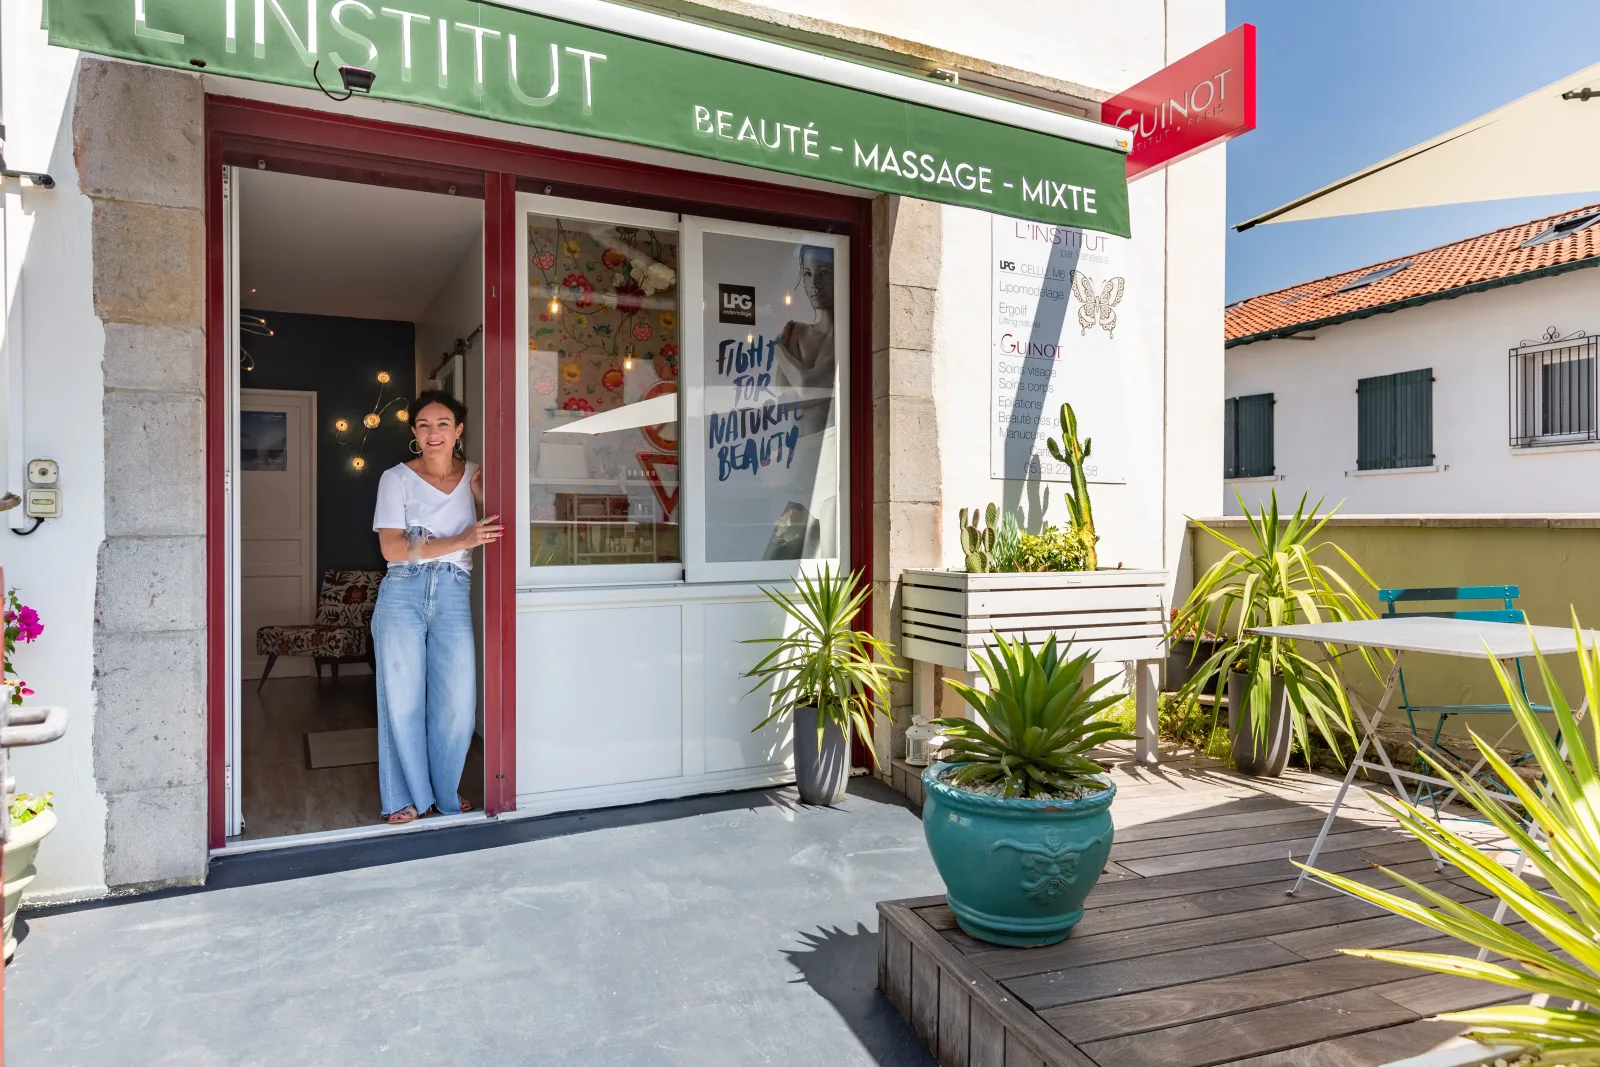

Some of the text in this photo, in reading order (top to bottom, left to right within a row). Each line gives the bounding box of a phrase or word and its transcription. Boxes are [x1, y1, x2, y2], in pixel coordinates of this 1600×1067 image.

[1187, 103, 1225, 128] PARIS
[694, 105, 820, 160] BEAUTÉ
[853, 138, 993, 194] MASSAGE
[1022, 175, 1098, 214] MIXTE
[1015, 221, 1109, 252] L'INSTITUT
[1060, 249, 1074, 260] par
[999, 259, 1016, 271] LPG
[1052, 268, 1066, 279] M6
[723, 292, 753, 310] LPG
[999, 280, 1064, 302] Lipomodelage
[716, 335, 784, 376] FIGHT
[999, 361, 1057, 379] Soins visage
[732, 372, 777, 407] FOR
[999, 378, 1054, 393] Soins corps
[709, 392, 804, 449] NATURAL
[998, 411, 1032, 425] Beauté
[1034, 413, 1051, 426] des
[999, 427, 1046, 440] Manucure
[717, 425, 799, 481] BEAUTY
